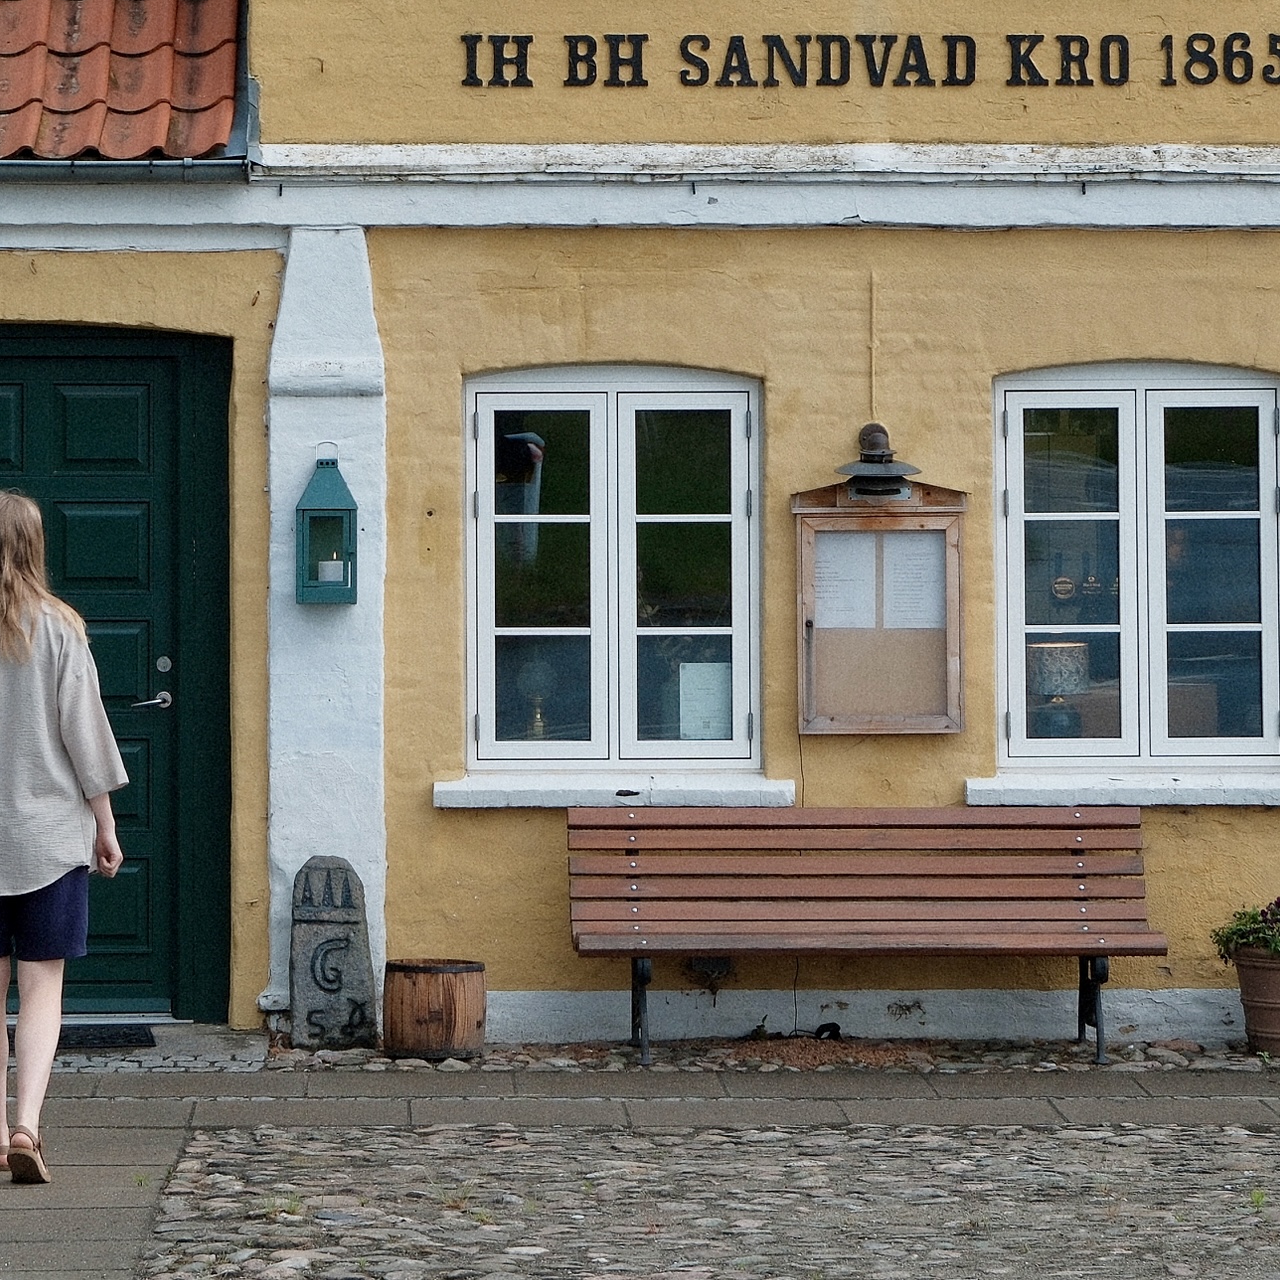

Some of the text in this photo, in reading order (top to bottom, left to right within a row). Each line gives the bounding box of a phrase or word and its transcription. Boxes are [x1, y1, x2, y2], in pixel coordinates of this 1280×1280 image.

[460, 33, 534, 88] IH
[563, 33, 649, 88] BH
[679, 33, 977, 88] SANDVAD
[1005, 33, 1131, 88] KRO
